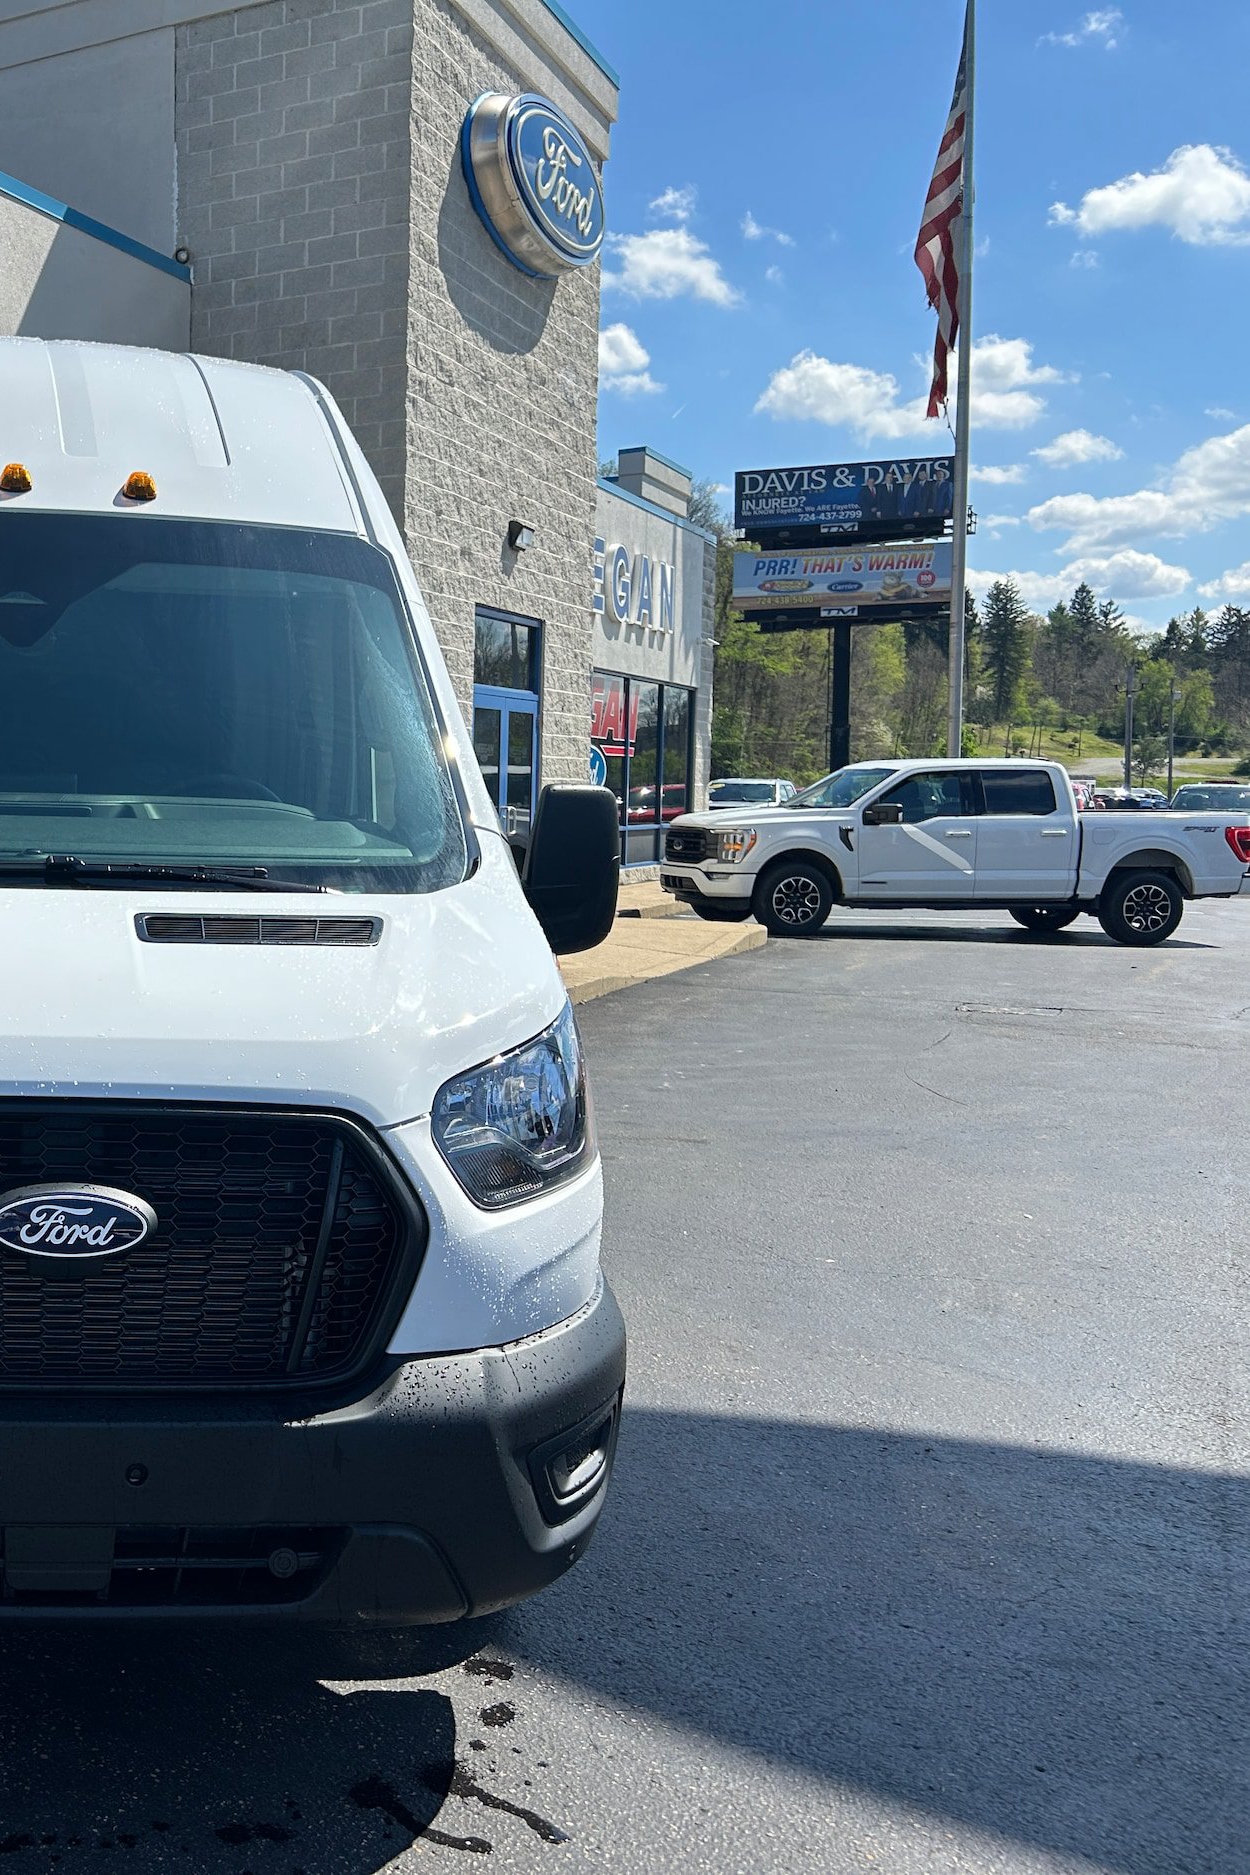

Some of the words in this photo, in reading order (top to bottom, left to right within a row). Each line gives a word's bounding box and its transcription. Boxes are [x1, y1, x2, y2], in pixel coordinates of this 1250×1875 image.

[536, 126, 596, 237] Ford
[742, 469, 827, 495] DAVIS
[832, 467, 856, 488] &
[861, 460, 950, 487] DAVIS
[741, 496, 807, 511] INJURED?
[798, 510, 863, 522] 724-437-2799
[753, 558, 798, 577] PRR!
[802, 555, 864, 575] THAT'S
[867, 552, 935, 572] WARM!
[831, 582, 860, 591] Carrier
[19, 1204, 118, 1246] Ford
